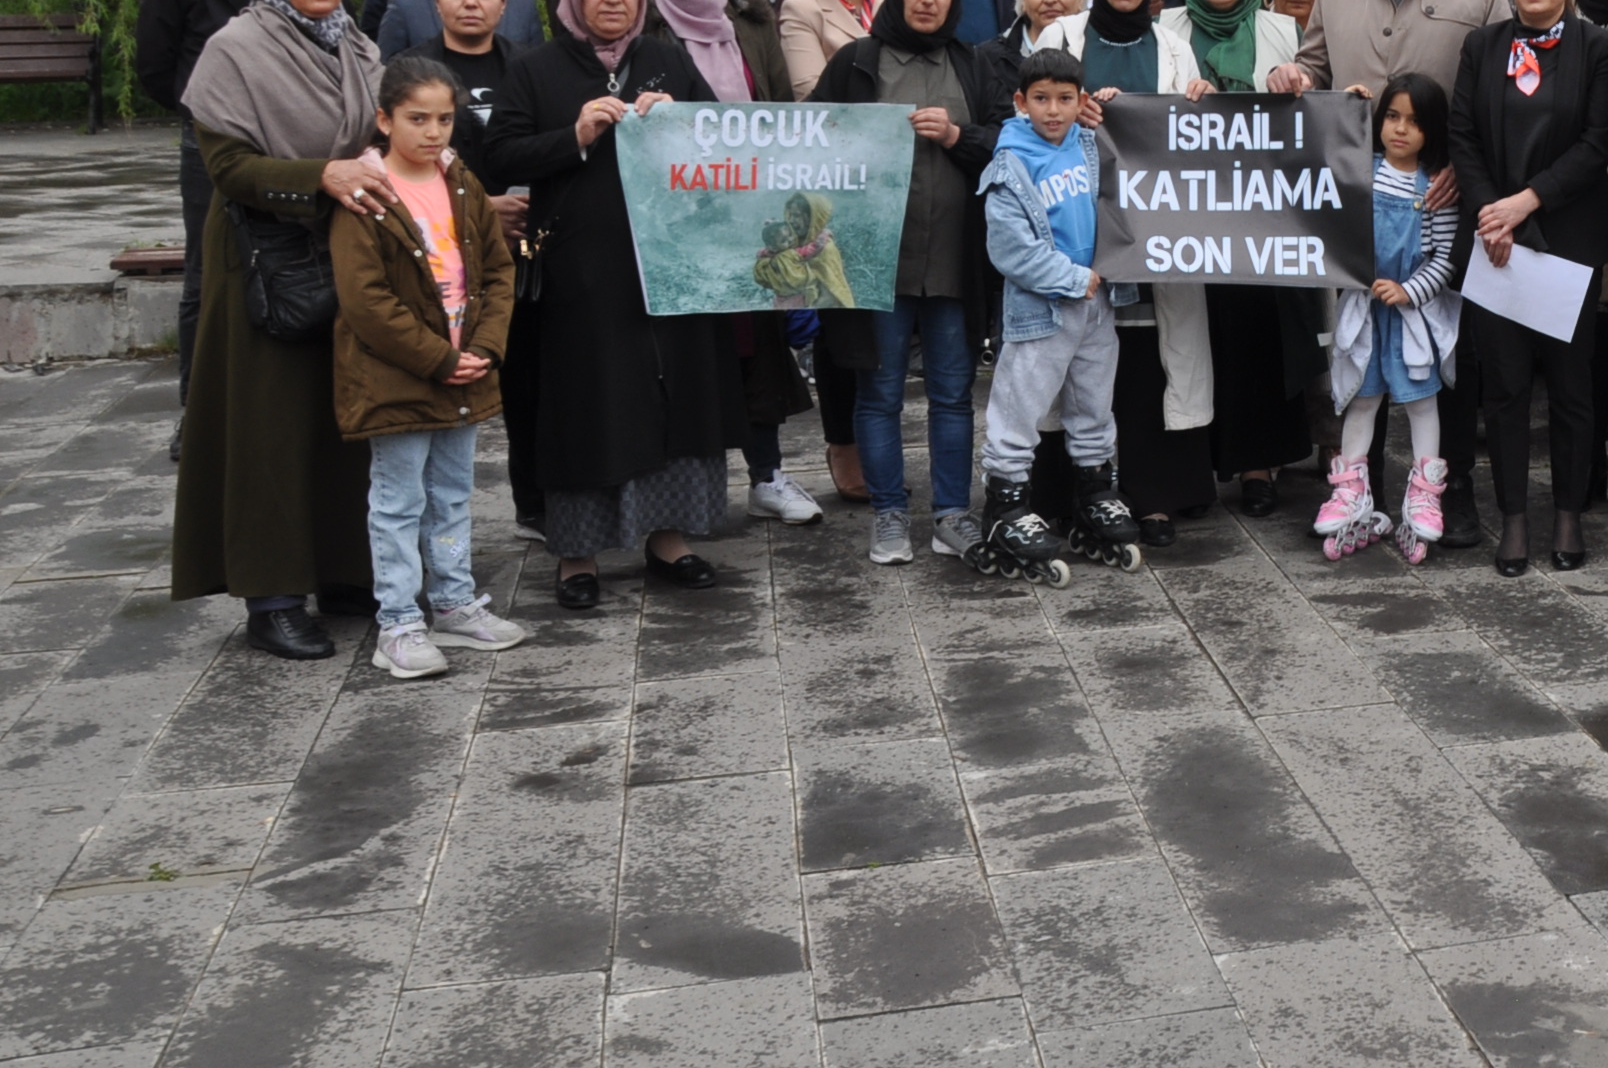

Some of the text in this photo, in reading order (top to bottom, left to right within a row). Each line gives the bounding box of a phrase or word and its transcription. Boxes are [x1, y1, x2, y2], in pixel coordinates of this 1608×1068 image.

[694, 108, 830, 157] ÇOCUK
[1168, 104, 1284, 151] İSRAİL
[669, 157, 867, 191] KATİLİ İSRAİL!
[1118, 160, 1343, 211] KATLİAMA
[1145, 235, 1327, 276] SON VER
